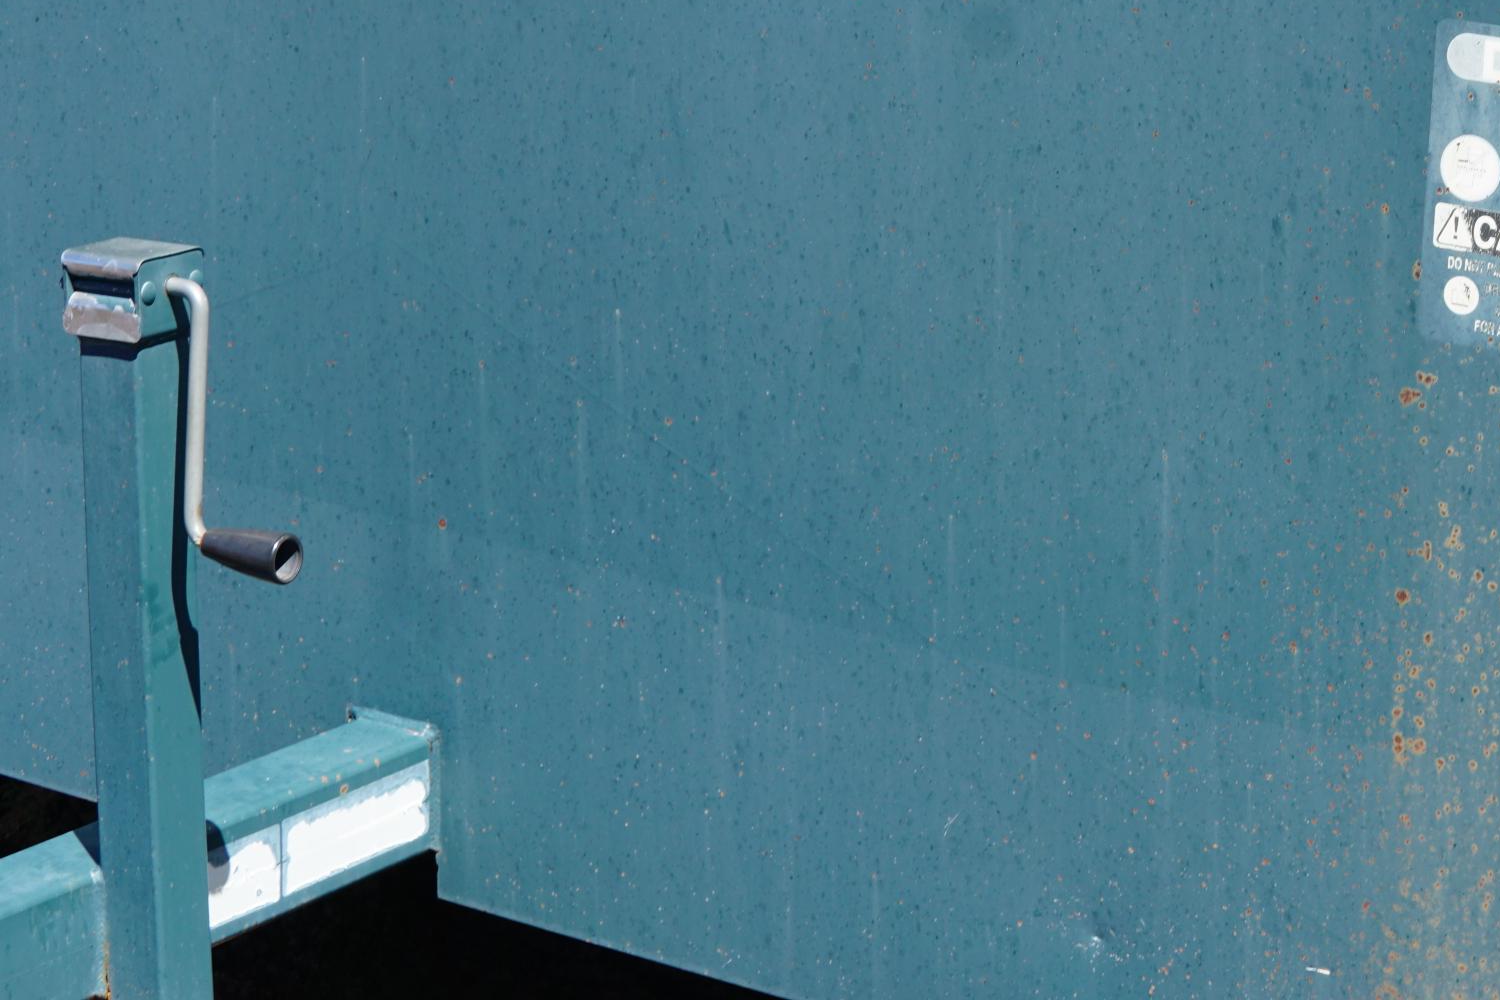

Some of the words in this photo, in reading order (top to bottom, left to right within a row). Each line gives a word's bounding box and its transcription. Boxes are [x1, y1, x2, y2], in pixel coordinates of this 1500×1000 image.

[1447, 256, 1463, 271] DO
[1464, 259, 1484, 274] NOT
[1474, 320, 1495, 336] FOR
